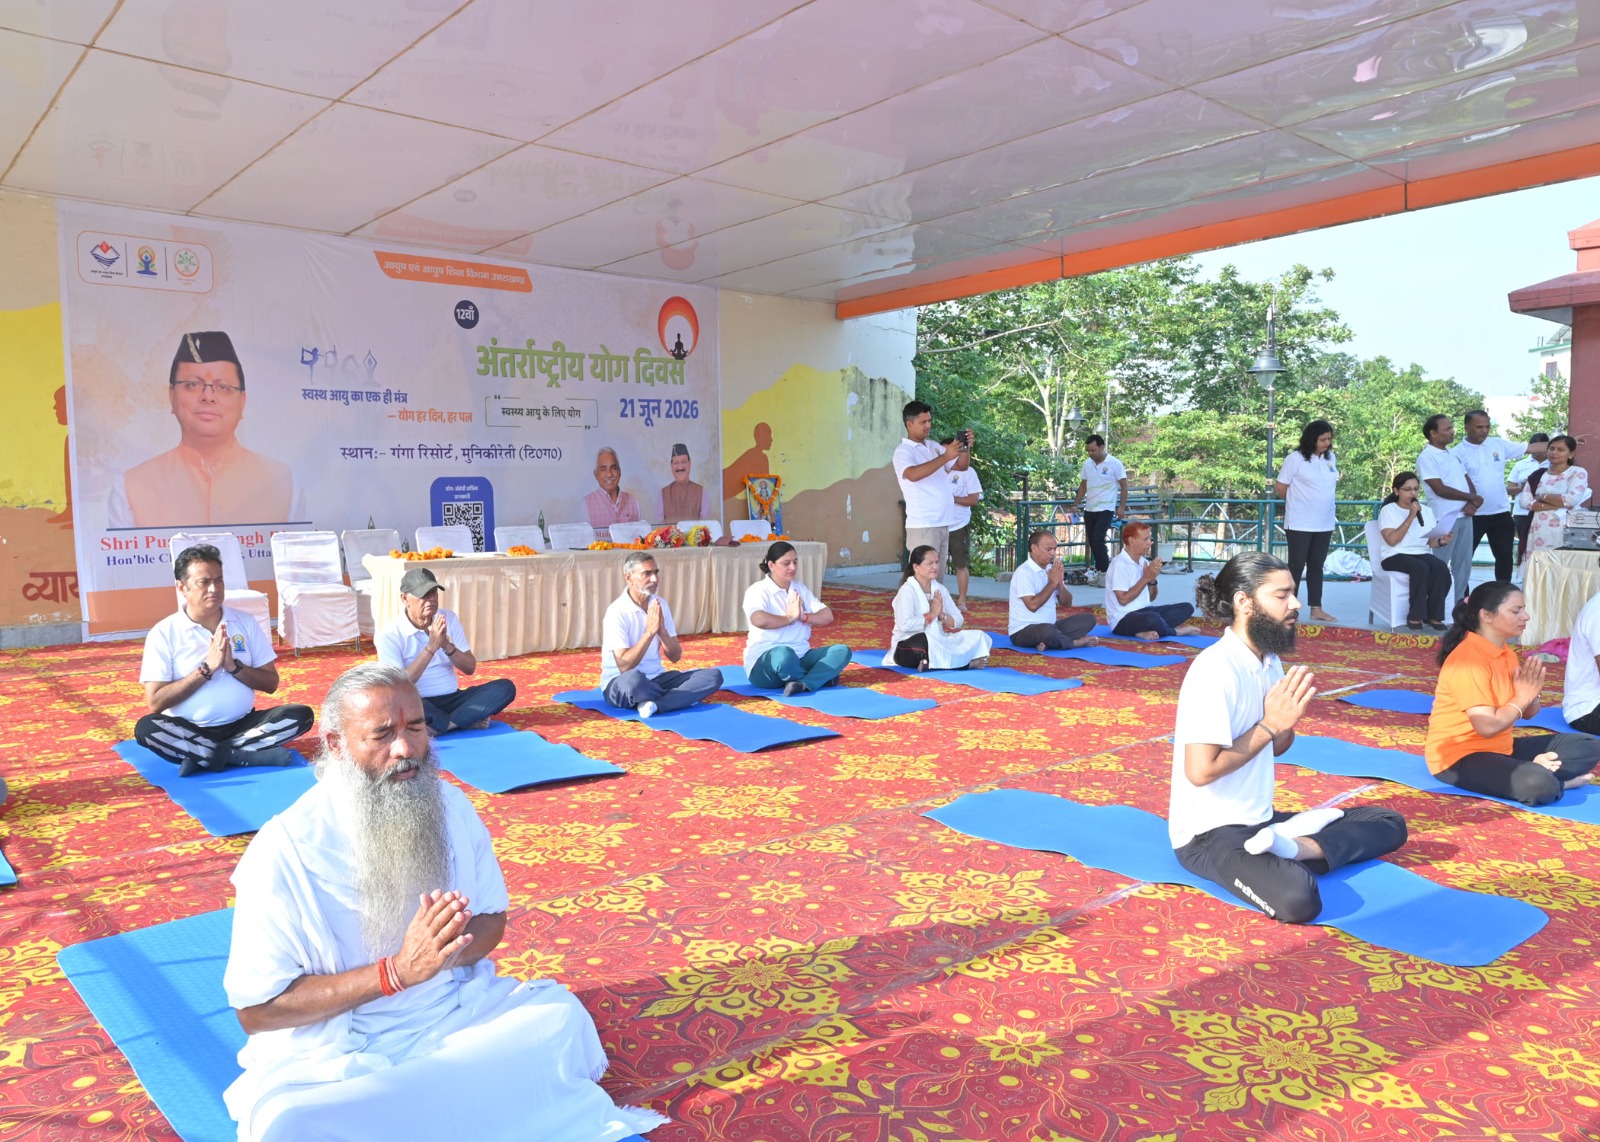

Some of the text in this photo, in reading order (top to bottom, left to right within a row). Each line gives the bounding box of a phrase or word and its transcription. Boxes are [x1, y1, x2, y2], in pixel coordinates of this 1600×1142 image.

[476, 337, 686, 388] अंतर्राष्ट्रीय योग दिवस
[301, 388, 408, 406] स्वस्थ आयु का एक ही मंत्र
[397, 407, 415, 421] योग
[416, 410, 428, 423] हर
[428, 408, 446, 423] दिन,
[447, 411, 458, 423] हर
[459, 412, 473, 422] पल
[525, 408, 542, 420] आयु
[542, 405, 550, 417] के
[551, 406, 566, 419] लिए
[567, 406, 581, 418] योग
[619, 398, 699, 427] 21 जून 2026
[390, 445, 414, 459] गंगा
[460, 444, 517, 464] मुनिकीरेती
[100, 536, 138, 551] Shri
[235, 531, 264, 548] ngh
[106, 554, 155, 566] Hon'ble
